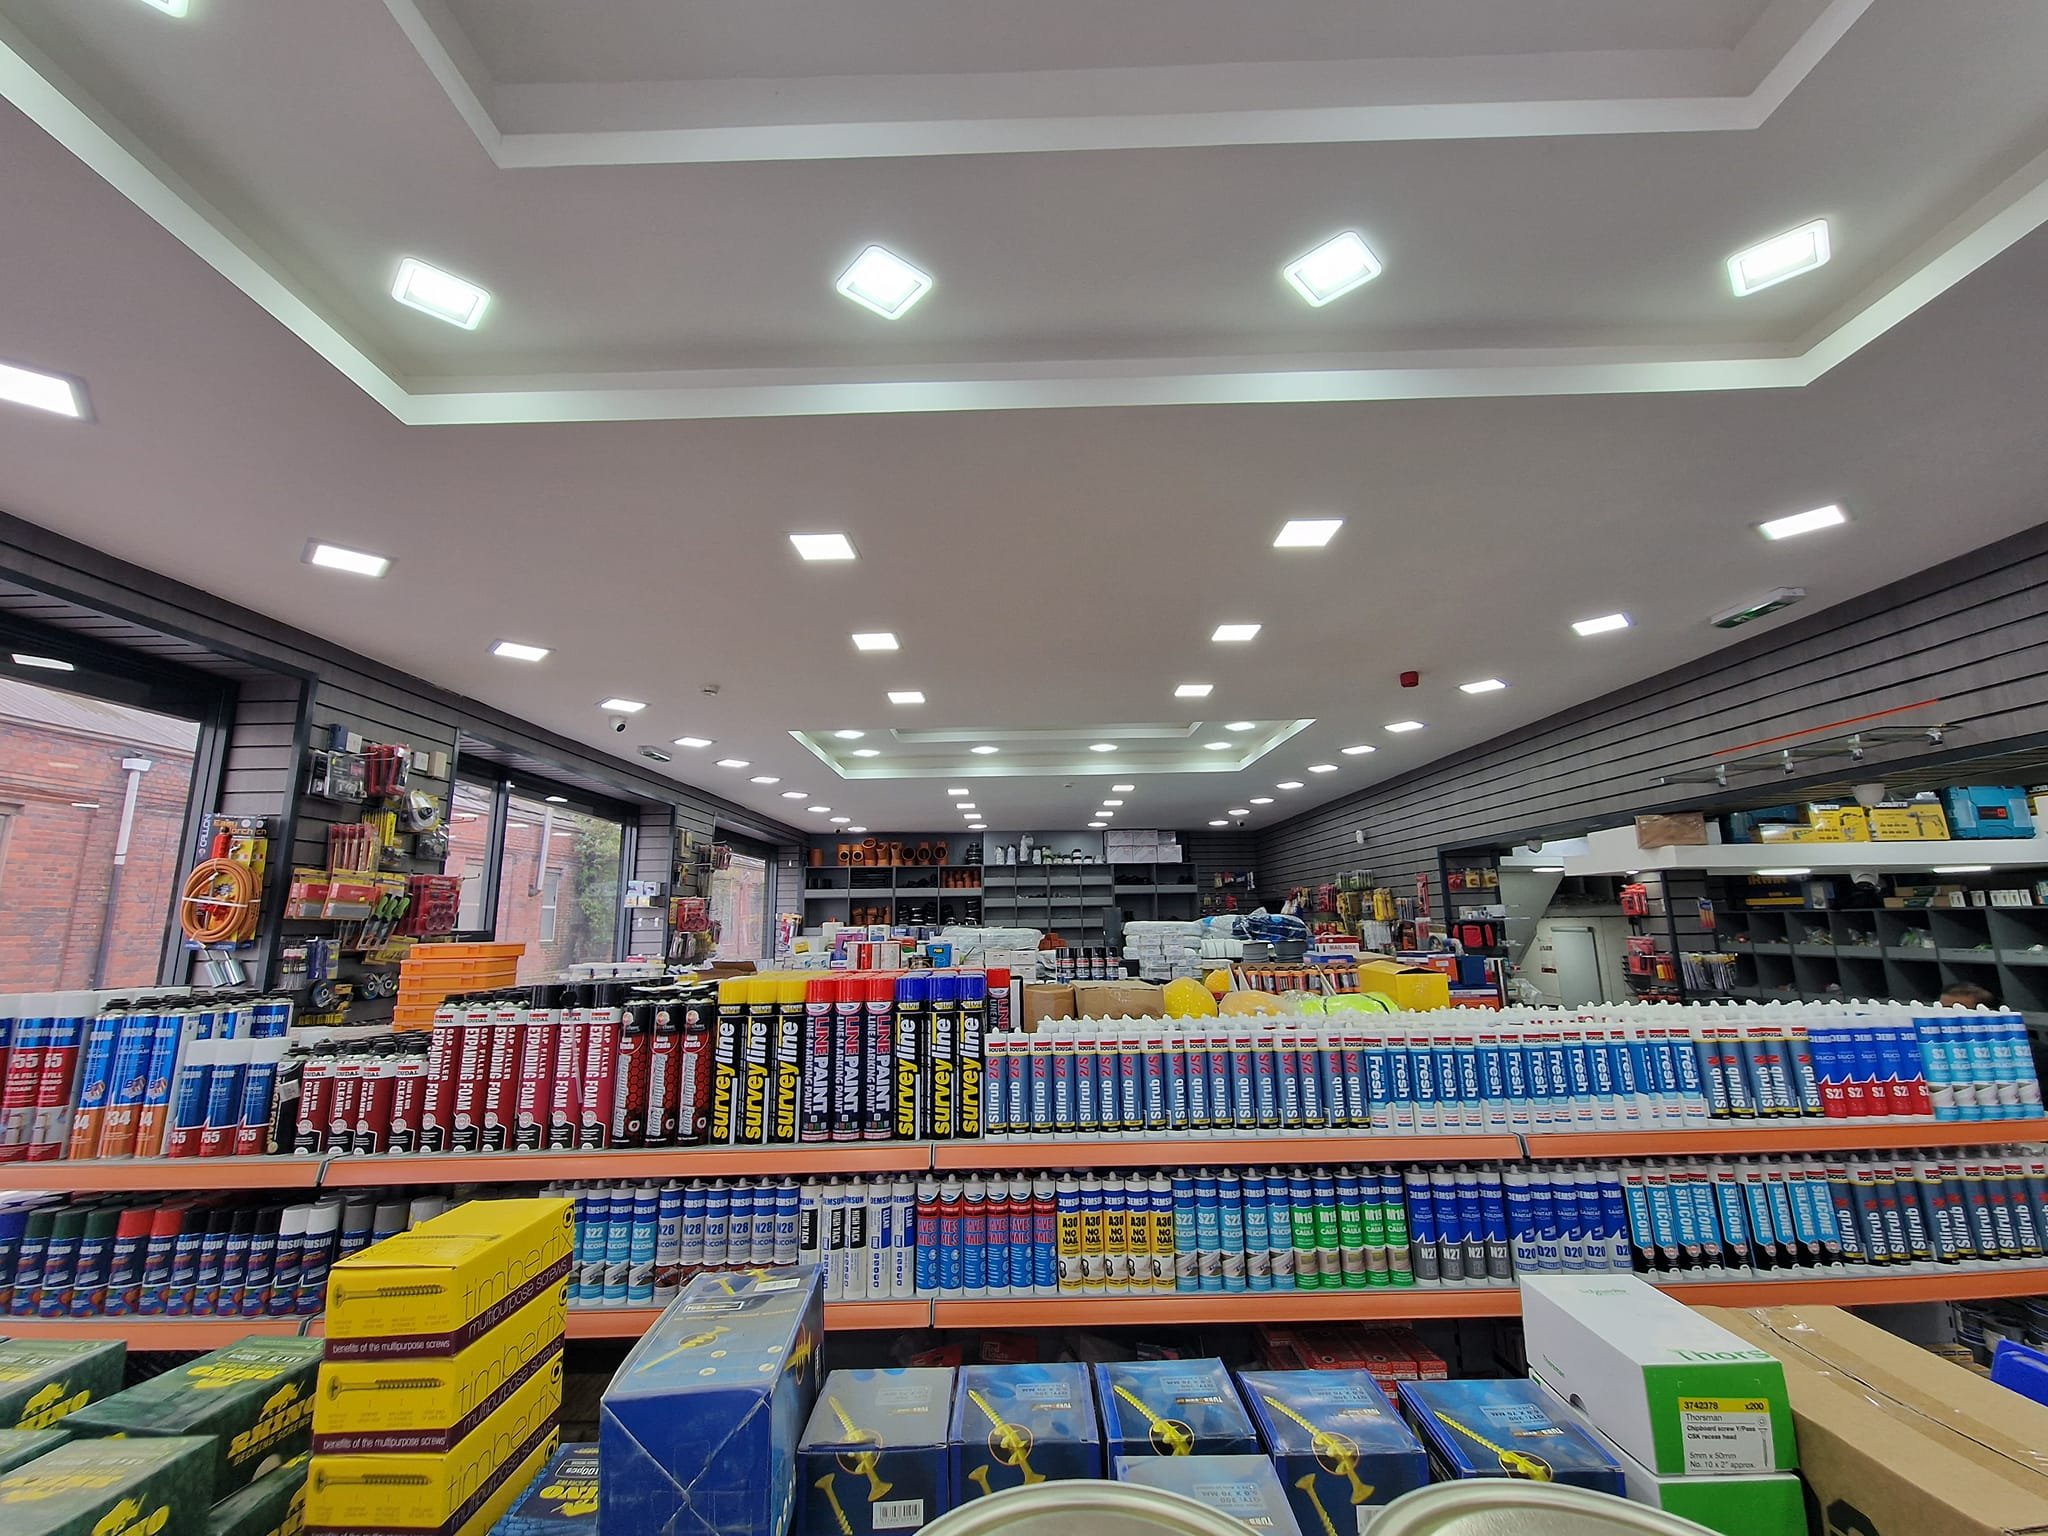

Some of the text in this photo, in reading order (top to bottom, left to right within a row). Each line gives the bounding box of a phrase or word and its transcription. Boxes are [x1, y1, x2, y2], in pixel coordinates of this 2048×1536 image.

[424, 1028, 446, 1111] EXPANDING FOAM
[441, 1029, 454, 1081] GAP FILLER
[456, 1028, 477, 1110] EXPANDING FOAM
[476, 1028, 488, 1080] GAP FILLER
[486, 1027, 507, 1109] EXPANDING FOAM
[503, 1027, 516, 1080] GAP FILLER
[519, 1027, 541, 1109] EXPANDING FOAM
[537, 1027, 549, 1079] GAP FILLER
[553, 1027, 573, 1107] EXPANDING FOAM
[583, 1026, 604, 1108] EXPANDING FOAM
[600, 1026, 611, 1079] GAP FILLER
[805, 1042, 813, 1085] MARKING
[813, 1017, 829, 1114] LINE PAINT
[844, 1016, 859, 1113] LINE PAINT
[867, 1041, 875, 1084] MARKING
[875, 1016, 890, 1112] LINE PAINT
[1508, 1051, 1525, 1096] Fresh
[1549, 1050, 1567, 1094] Fresh
[1594, 1048, 1612, 1092] Fresh
[1659, 1046, 1676, 1090] Fresh
[1679, 1046, 1699, 1089] Fresh
[1350, 1076, 1363, 1118] Silirub
[1369, 1055, 1386, 1099] Fresh
[1418, 1055, 1434, 1099] Fresh
[1463, 1054, 1480, 1098] Fresh
[1710, 1067, 1727, 1108] Silirub
[1726, 1067, 1745, 1108] Silirub
[1800, 1065, 1820, 1106] Silirub
[301, 1080, 313, 1119] CLEANER
[334, 1081, 347, 1119] CLEANER
[358, 1082, 370, 1119] CLEANER
[394, 1080, 407, 1118] CLEANER
[804, 1086, 812, 1114] PAINT
[835, 1086, 843, 1114] PAINT
[866, 1085, 874, 1112] PAINT
[989, 1082, 1000, 1123] Silirub
[1035, 1081, 1046, 1122] Silirub
[1079, 1080, 1091, 1122] Silirub
[1124, 1079, 1135, 1121] Silirub
[1192, 1077, 1204, 1119] Silirub
[1238, 1077, 1250, 1118] Silirub
[1286, 1077, 1298, 1119] Silirub
[1062, 1216, 1078, 1228] A30
[1085, 1215, 1101, 1227] A30
[1108, 1215, 1124, 1227] A30
[1111, 1227, 1123, 1236] NO
[1175, 1213, 1193, 1225] S22
[1199, 1212, 1216, 1225] S22
[1248, 1213, 1265, 1225] S22
[1632, 1190, 1650, 1243] SILICONE
[1653, 1190, 1674, 1243] SILICONE
[1693, 1187, 1715, 1240] SILICONE
[1724, 1187, 1743, 1240] SILICONE
[1812, 1185, 1834, 1236] SILICONE
[1837, 1209, 1858, 1253] Silirub
[1905, 1207, 1927, 1250] Silirub
[1976, 1207, 1996, 1250] Silirub
[2016, 1204, 2036, 1247] Silirub
[586, 1226, 604, 1239] S22
[1062, 1236, 1079, 1245] NAIL
[1064, 1229, 1077, 1237] NO
[1085, 1235, 1102, 1244] NAIL
[1087, 1228, 1100, 1236] NO
[1109, 1235, 1125, 1244] NAIL
[1490, 1246, 1507, 1259] N27
[1537, 1245, 1557, 1258] D20
[1588, 1245, 1606, 1258] D20
[1867, 1211, 1886, 1255] Silirub
[1518, 1247, 1536, 1260] D20
[468, 1283, 535, 1340] multipurpose
[535, 1259, 568, 1291] screws
[332, 1340, 450, 1354] benefits of the multipurpose screws
[463, 1338, 562, 1433] multipurpose screws
[1683, 1401, 1764, 1410] 3742378 x200
[1685, 1413, 1723, 1422] Thorsman
[1686, 1425, 1717, 1434] Chipboard
[1722, 1432, 1736, 1440] head
[1689, 1452, 1708, 1460] 5mm
[1715, 1451, 1736, 1459] 50mm
[1690, 1460, 1704, 1469] No.
[1705, 1460, 1714, 1468] 10
